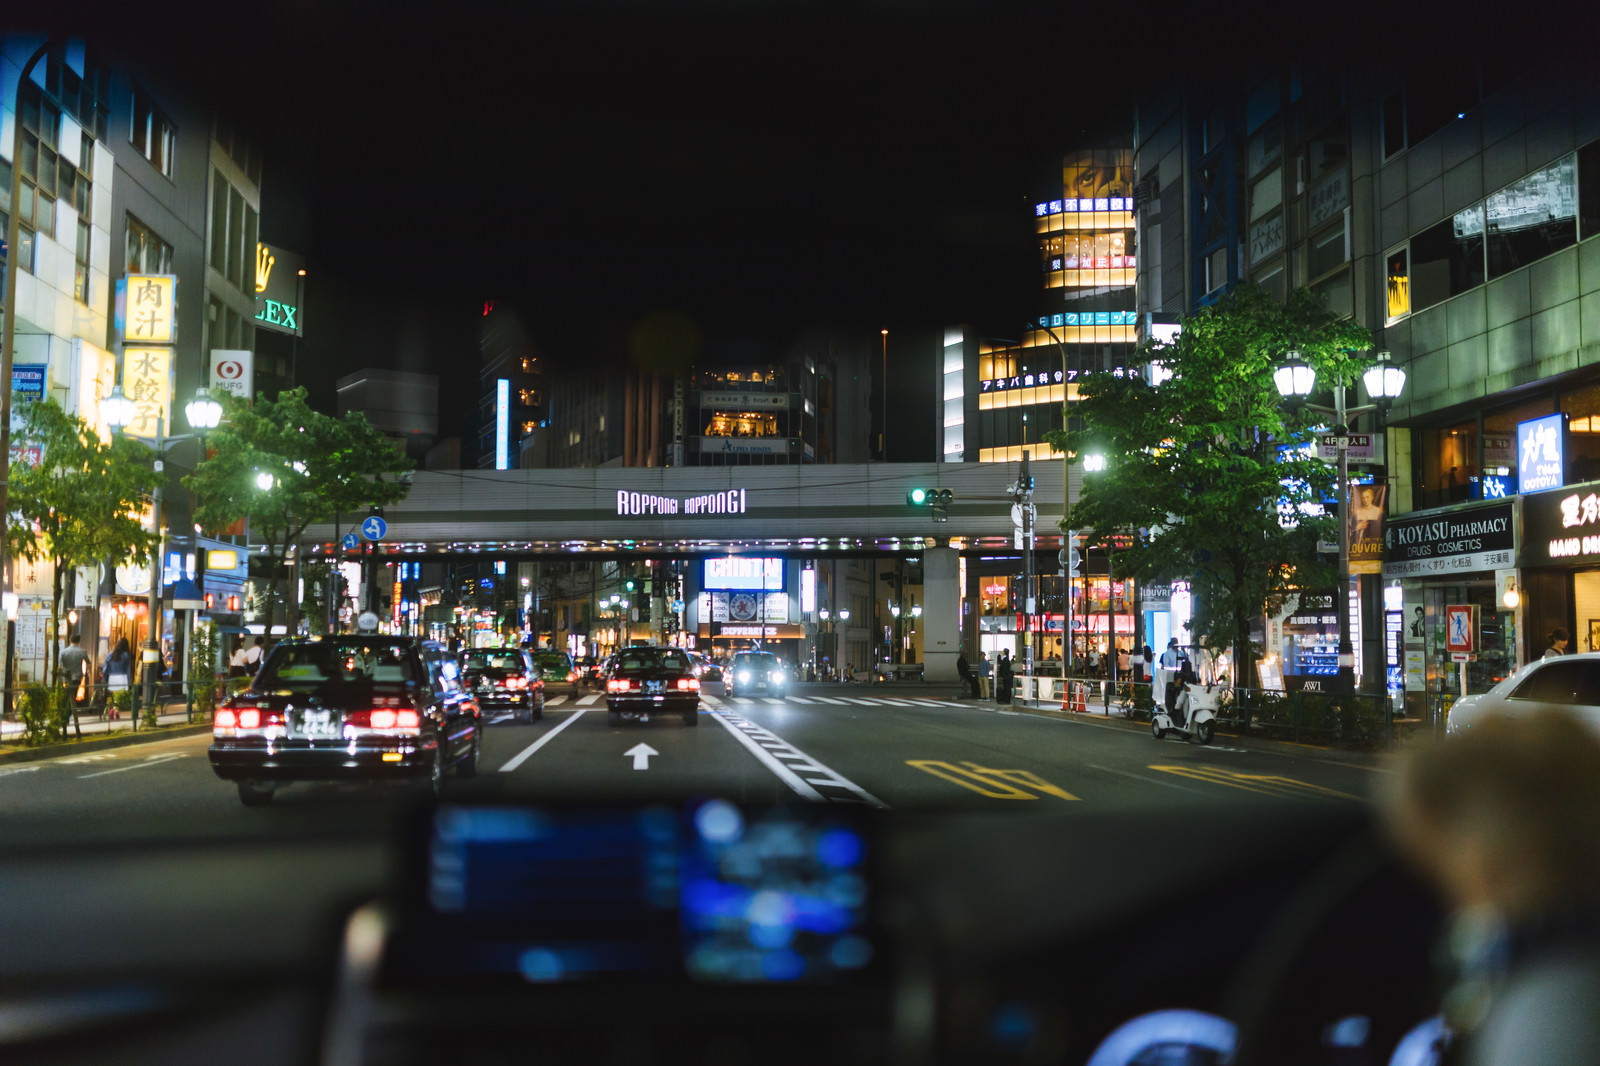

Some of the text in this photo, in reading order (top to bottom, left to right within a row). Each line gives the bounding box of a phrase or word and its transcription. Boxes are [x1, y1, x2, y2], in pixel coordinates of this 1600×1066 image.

[135, 279, 163, 339] 肉汁
[133, 351, 161, 433] 水餃子
[216, 381, 243, 390] MUFG
[982, 372, 1048, 391] アキバ歯科
[1524, 475, 1558, 490] OOTOYA
[617, 488, 746, 515] ROPPONGI ROPPONGI
[1560, 493, 1600, 528] 星乃
[1398, 517, 1508, 545] KOYASU PHARMACY
[1350, 543, 1384, 554] OUVRE
[1407, 538, 1482, 557] DRUGS COSMETICS
[1549, 535, 1600, 558] HAND DR
